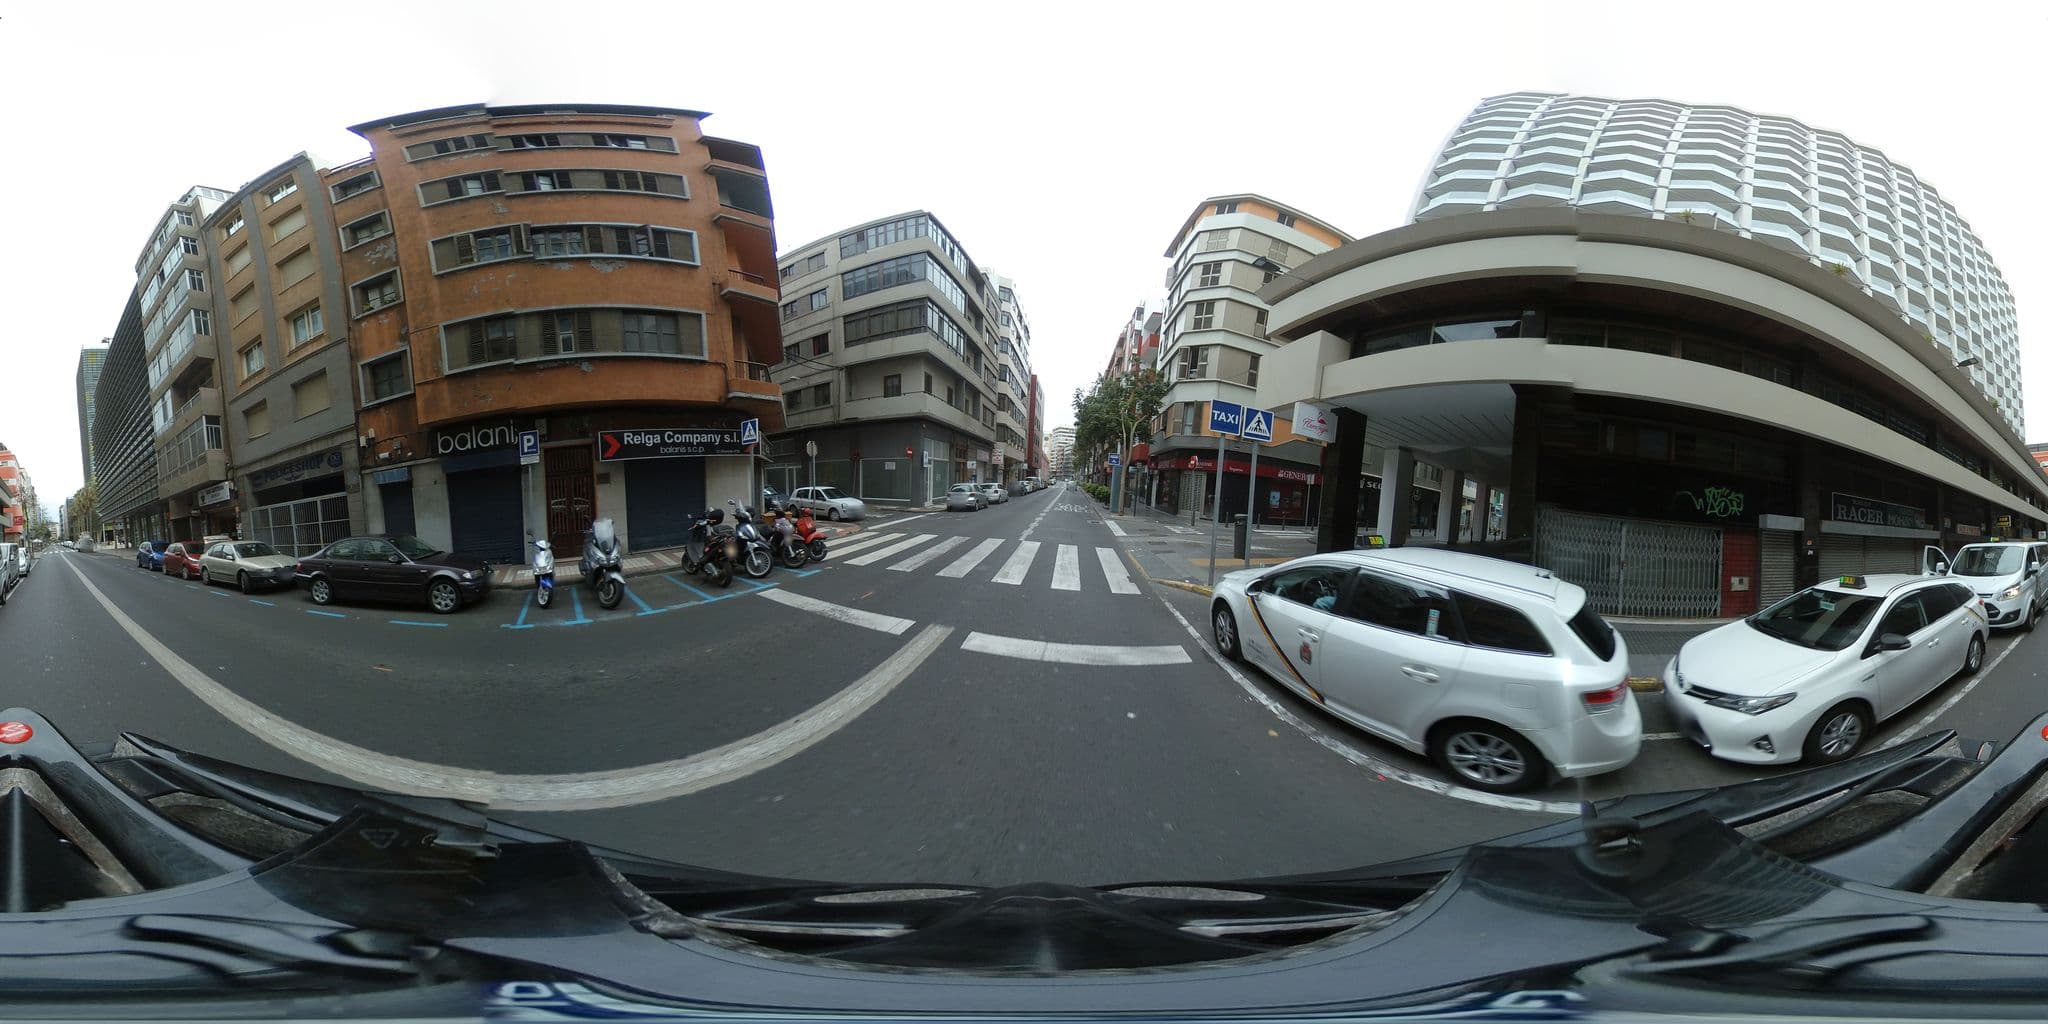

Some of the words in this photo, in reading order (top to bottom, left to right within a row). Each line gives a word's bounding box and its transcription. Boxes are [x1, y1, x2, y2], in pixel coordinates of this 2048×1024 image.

[1212, 409, 1239, 425] TAXI
[523, 434, 535, 453] P
[623, 432, 661, 447] Relga
[664, 431, 721, 446] Company
[724, 432, 740, 443] s.l.
[660, 446, 687, 454] balanis
[1836, 503, 1884, 524] RACER
